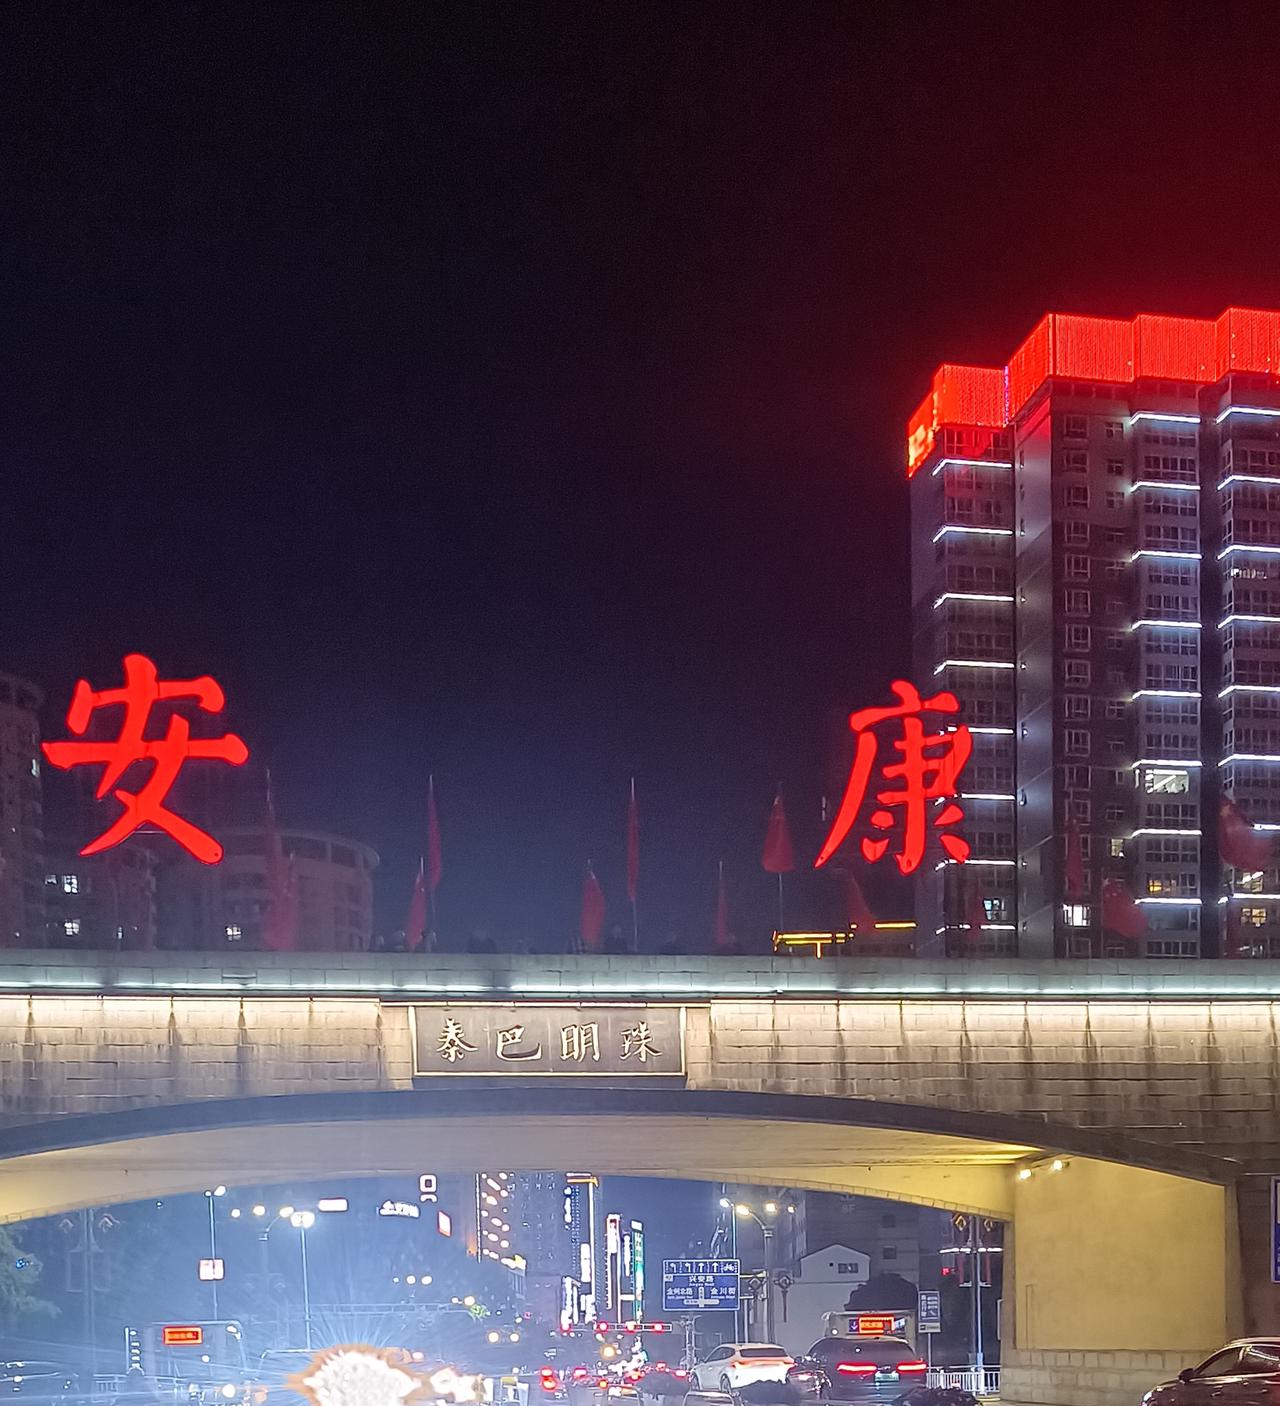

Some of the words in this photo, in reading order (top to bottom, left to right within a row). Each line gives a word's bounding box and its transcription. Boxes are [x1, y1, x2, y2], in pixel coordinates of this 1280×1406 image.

[41, 653, 249, 864] 安
[815, 679, 973, 876] 康
[436, 1018, 663, 1063] 秦巴明珠
